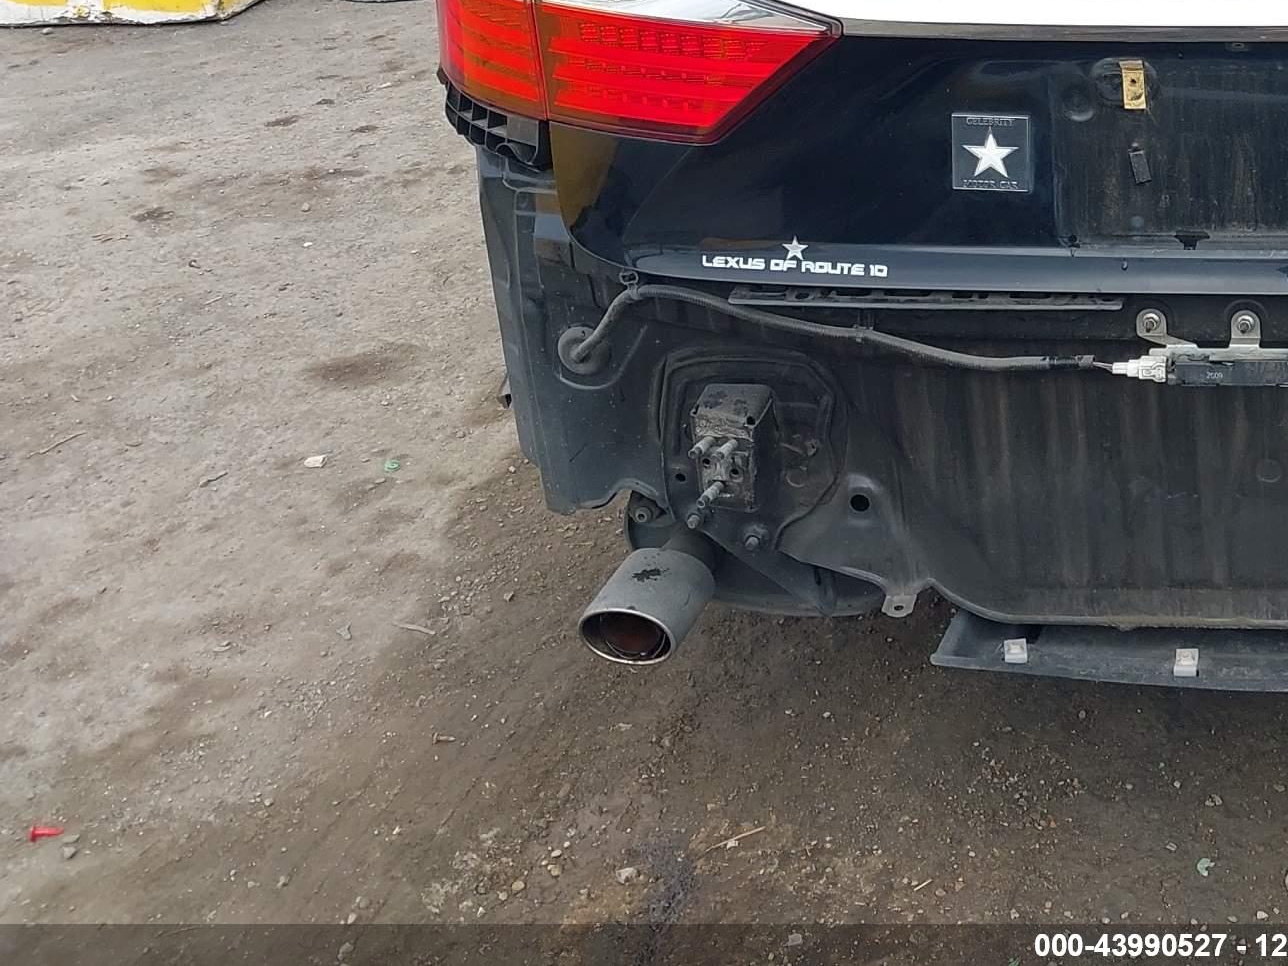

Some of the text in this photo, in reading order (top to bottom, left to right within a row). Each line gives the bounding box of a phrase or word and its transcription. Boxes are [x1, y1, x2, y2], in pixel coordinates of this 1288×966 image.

[966, 117, 1015, 127] CELEBRITY
[963, 179, 1018, 190] MOTOR CAR
[702, 255, 888, 277] LEXUS OF ROUTE 10
